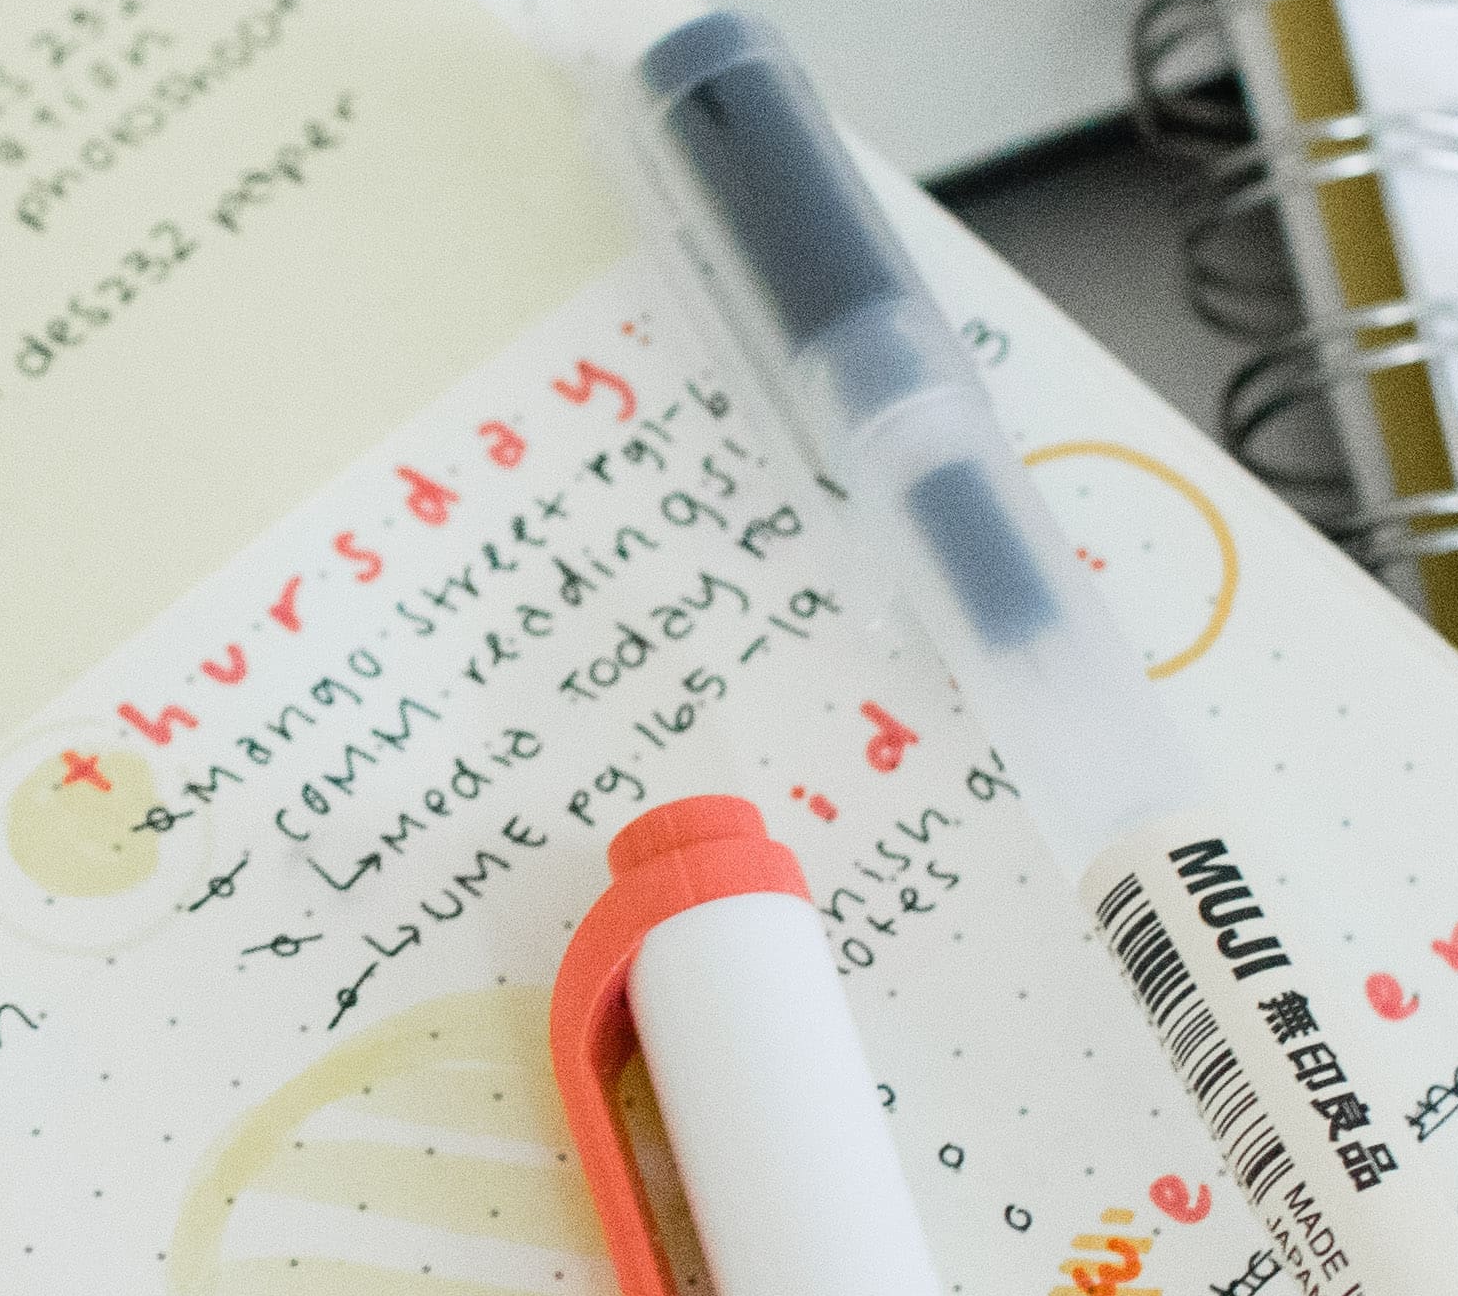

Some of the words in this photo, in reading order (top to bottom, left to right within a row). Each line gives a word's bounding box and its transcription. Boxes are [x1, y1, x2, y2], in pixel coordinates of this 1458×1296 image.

[209, 92, 355, 235] paper
[63, 320, 654, 792] thursday:
[395, 493, 567, 637] street
[1167, 836, 1293, 983] MUJI
[1256, 988, 1401, 1194] 無印良品
[1283, 1180, 1351, 1282] MADE
